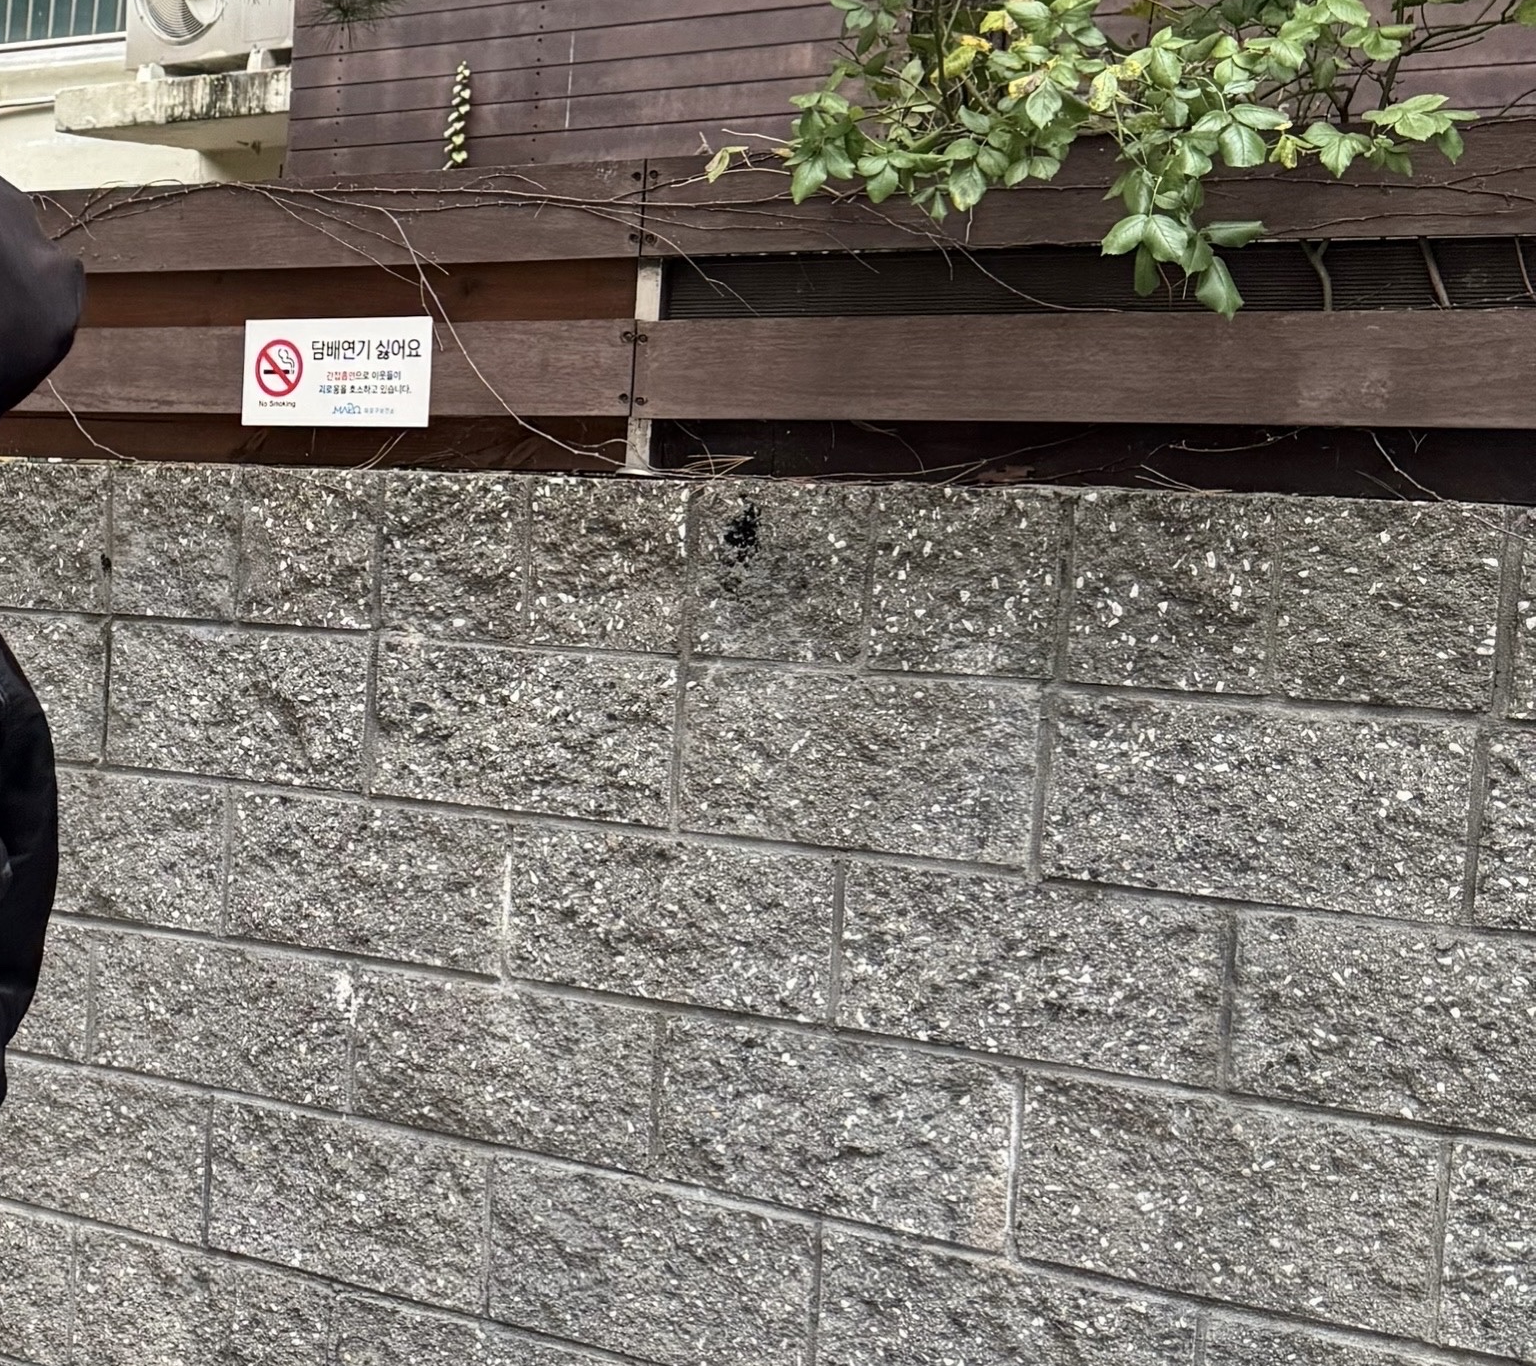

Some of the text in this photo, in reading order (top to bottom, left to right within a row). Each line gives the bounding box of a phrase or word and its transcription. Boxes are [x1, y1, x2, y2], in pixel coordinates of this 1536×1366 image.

[311, 338, 422, 361] 담배연기 싫어요
[259, 400, 296, 409] No Smoking
